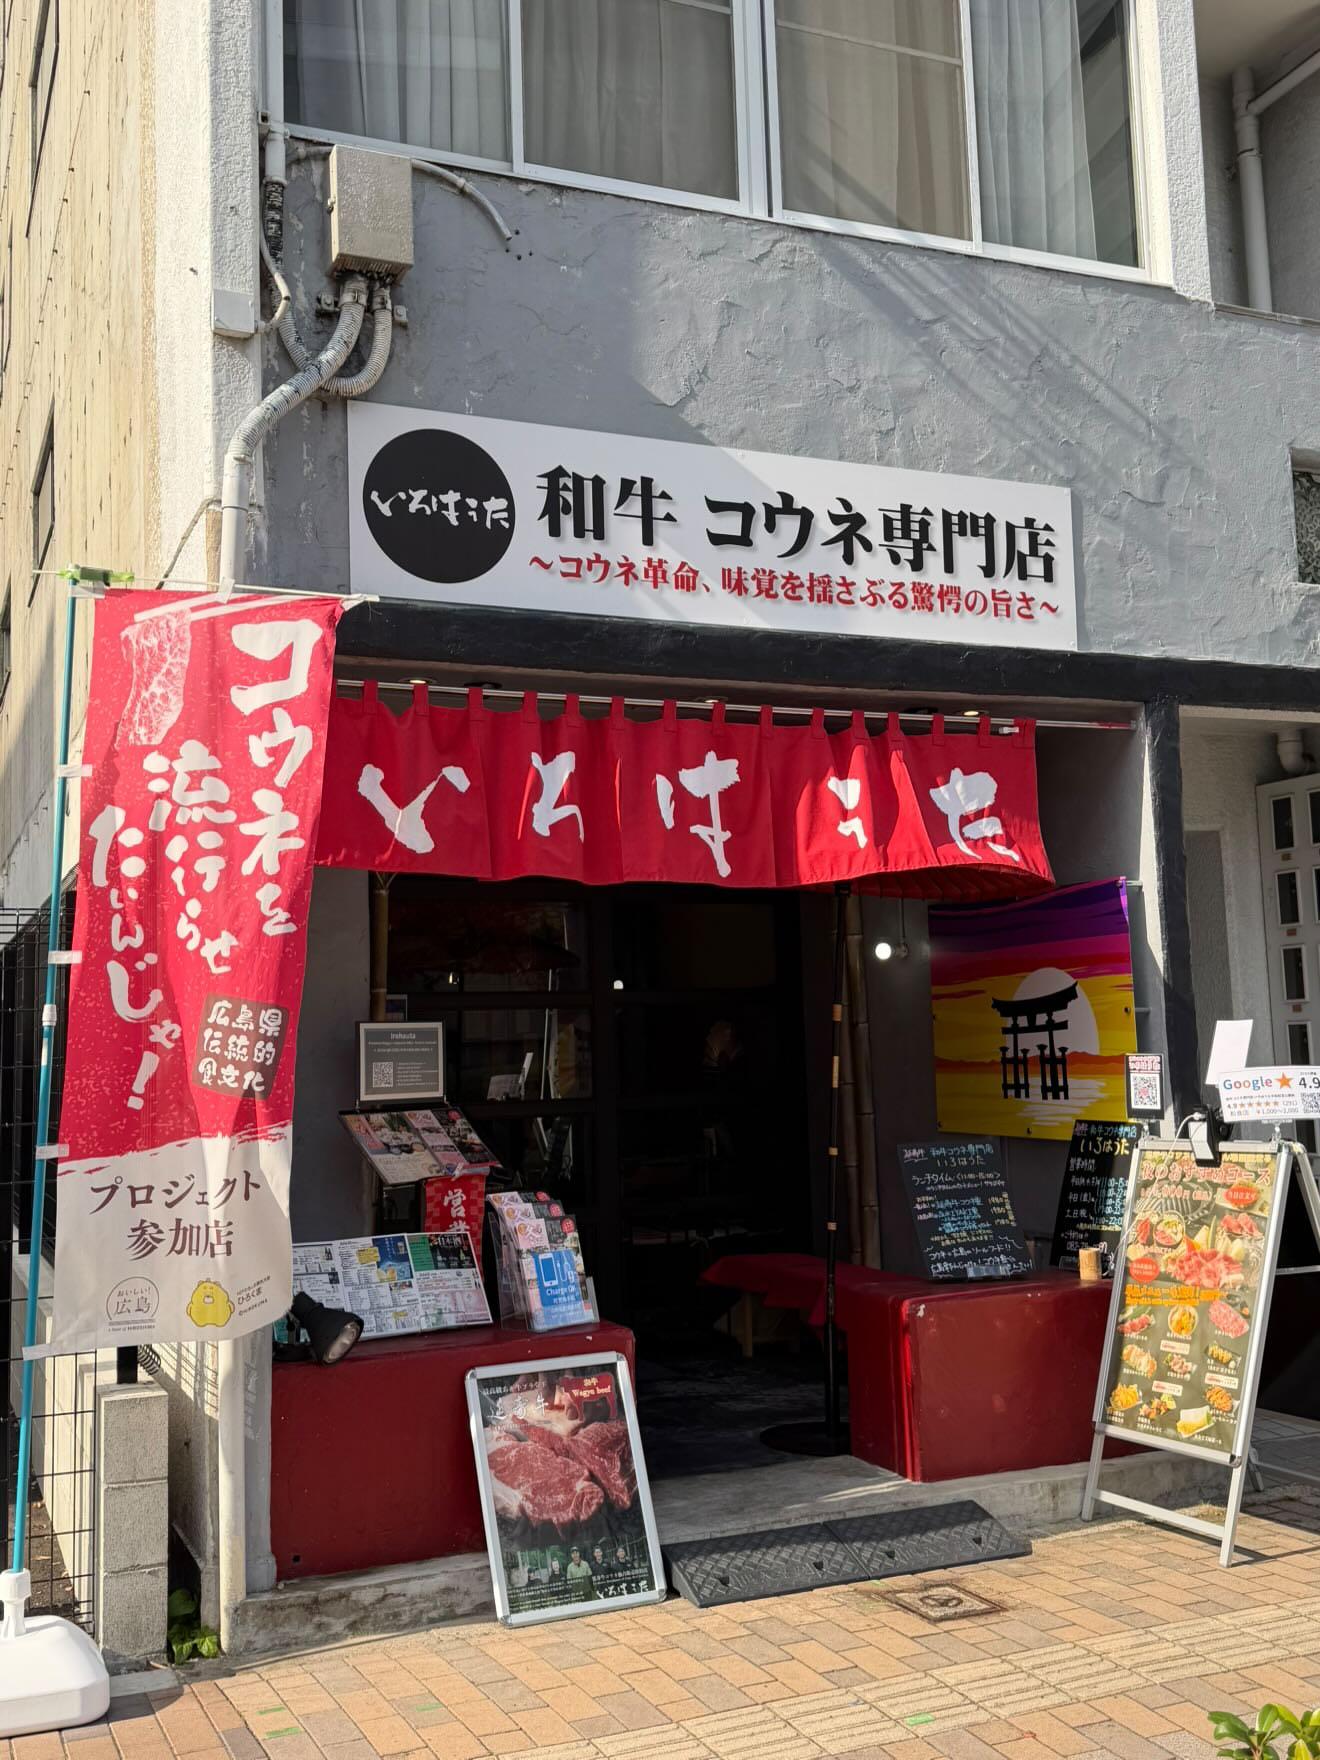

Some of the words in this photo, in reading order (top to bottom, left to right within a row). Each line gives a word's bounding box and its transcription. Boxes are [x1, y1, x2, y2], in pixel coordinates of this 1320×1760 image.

[370, 488, 511, 529] いろはうた
[536, 464, 678, 546] 和牛
[703, 491, 1056, 583] コウネ専門店
[230, 619, 323, 936] コウネを
[357, 749, 1021, 879] いろはうた
[142, 739, 238, 974] 流行らせ
[208, 1000, 283, 1038] 広島県
[202, 1027, 277, 1065] 伝統的
[1223, 1076, 1272, 1091] Google
[936, 1155, 986, 1168] いろはうた
[1080, 1138, 1130, 1155] いろはうた
[89, 1169, 261, 1215] プロジェクト
[126, 1218, 234, 1261] 参加店
[114, 1296, 151, 1315] 広島
[237, 1286, 263, 1305] ひろくま
[571, 1389, 596, 1399] Wagyu
[597, 1386, 612, 1397] beef
